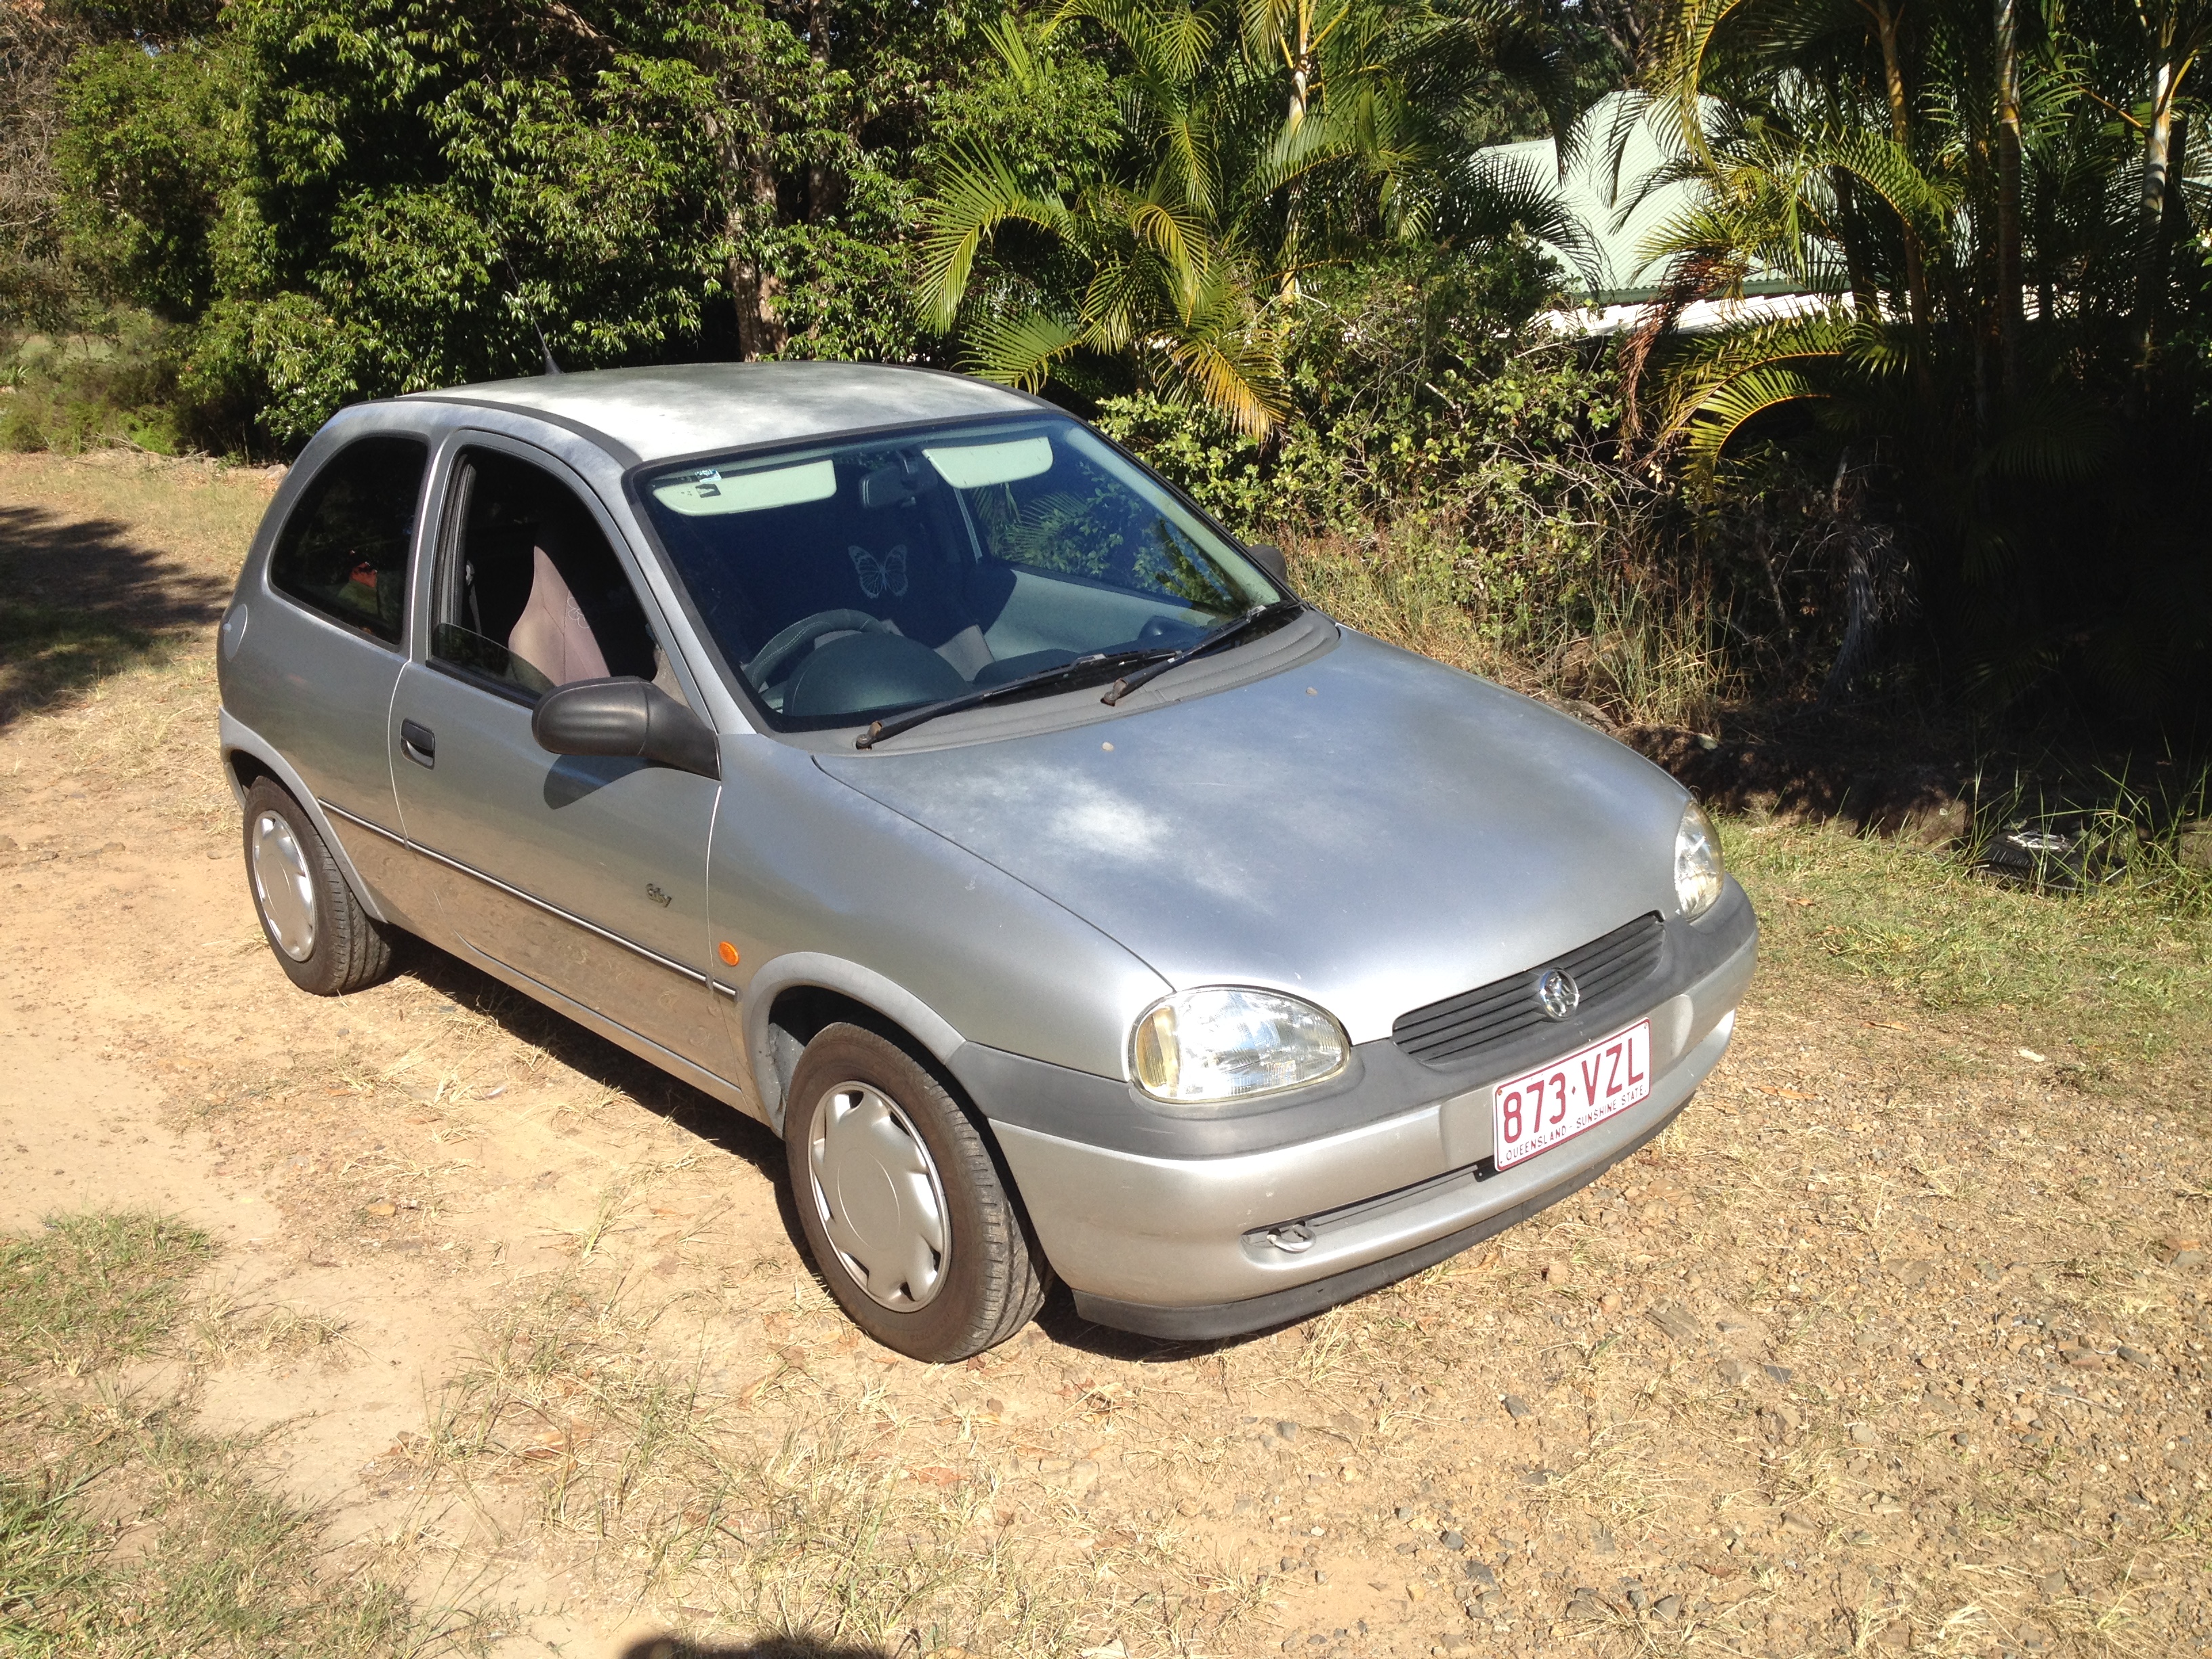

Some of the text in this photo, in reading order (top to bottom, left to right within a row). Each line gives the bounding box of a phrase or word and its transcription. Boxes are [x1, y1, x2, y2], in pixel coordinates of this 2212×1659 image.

[1506, 1126, 1566, 1161] QUEENSLAND
[1576, 1099, 1617, 1129] SUNSHINE
[1621, 1085, 1643, 1106] STATE
